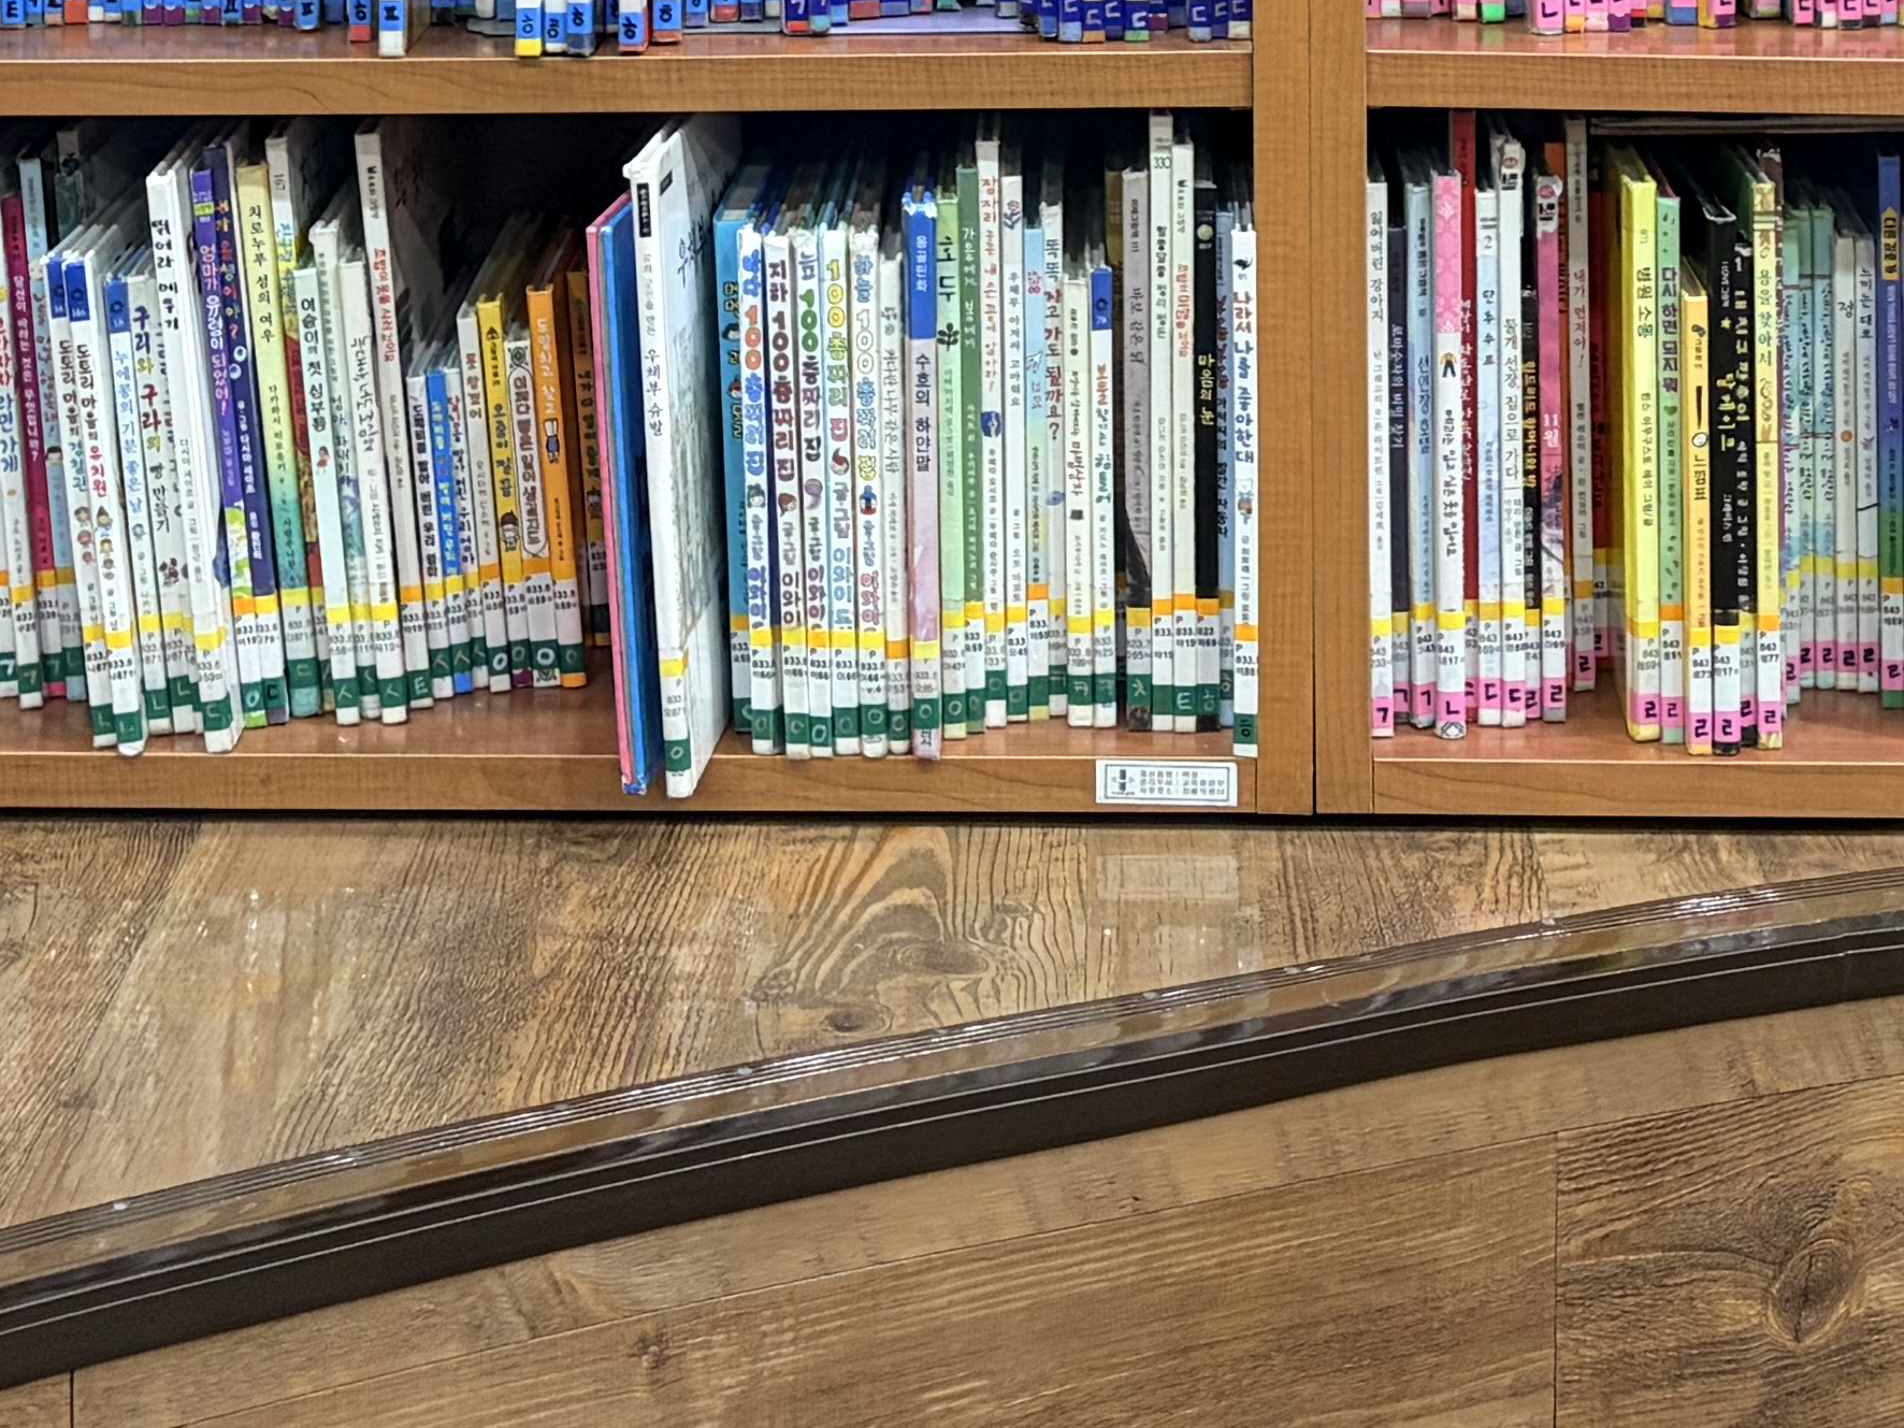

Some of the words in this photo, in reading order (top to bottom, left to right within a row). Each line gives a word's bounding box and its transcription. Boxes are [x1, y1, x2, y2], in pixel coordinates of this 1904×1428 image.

[768, 260, 788, 303] 지하
[1661, 268, 1678, 299] 다시
[1233, 292, 1253, 335] 나라서
[1661, 302, 1678, 335] 하면
[75, 343, 94, 390] 도토리
[1234, 341, 1253, 376] 나를
[1662, 341, 1678, 372] 되지
[914, 354, 932, 408] 수호의
[81, 395, 98, 441] 마을의
[1233, 386, 1255, 466] 좋아한대
[1542, 412, 1560, 449] 11월
[0, 437, 19, 474] 가게
[915, 416, 932, 473] 하얀말
[88, 444, 109, 498] 유치원
[776, 453, 795, 482] 집
